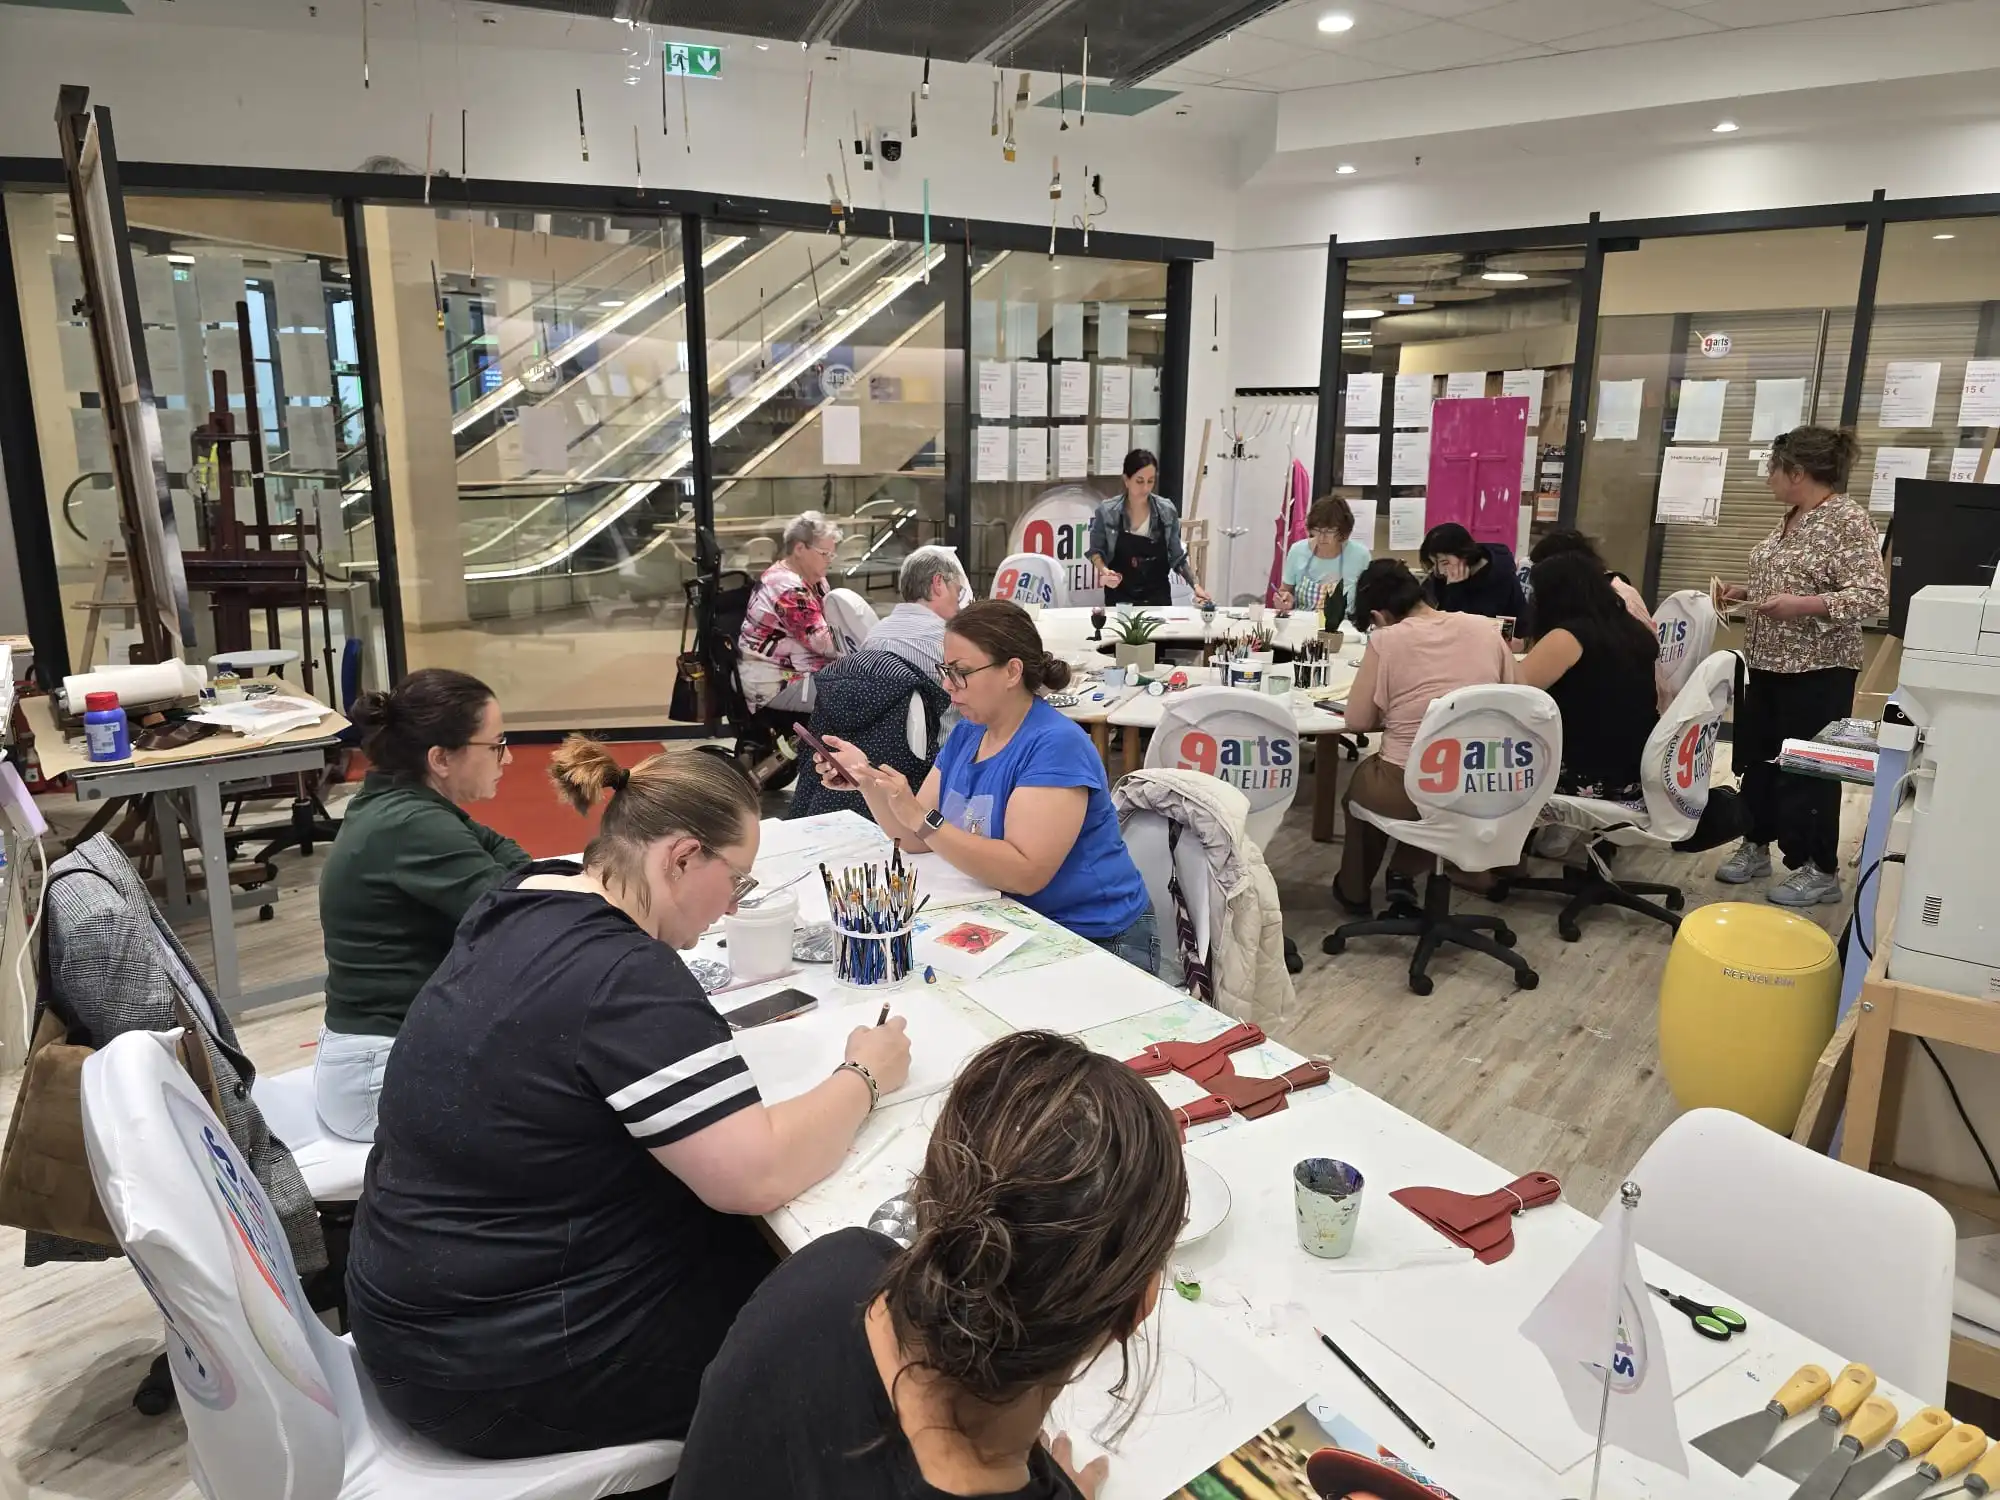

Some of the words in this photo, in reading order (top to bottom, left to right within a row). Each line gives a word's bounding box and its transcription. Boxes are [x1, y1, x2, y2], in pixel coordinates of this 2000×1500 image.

[1892, 387, 1900, 396] €
[1965, 385, 1977, 394] 15
[1979, 385, 1987, 394] €
[1873, 472, 1879, 480] 5
[1882, 472, 1889, 480] €
[1966, 472, 1973, 480] €
[1659, 618, 1687, 644] arts
[1660, 643, 1685, 663] ELIER
[1663, 734, 1681, 796] KUNSTHAUS
[1219, 769, 1292, 790] ATELIER
[1464, 768, 1534, 793] ATELIER
